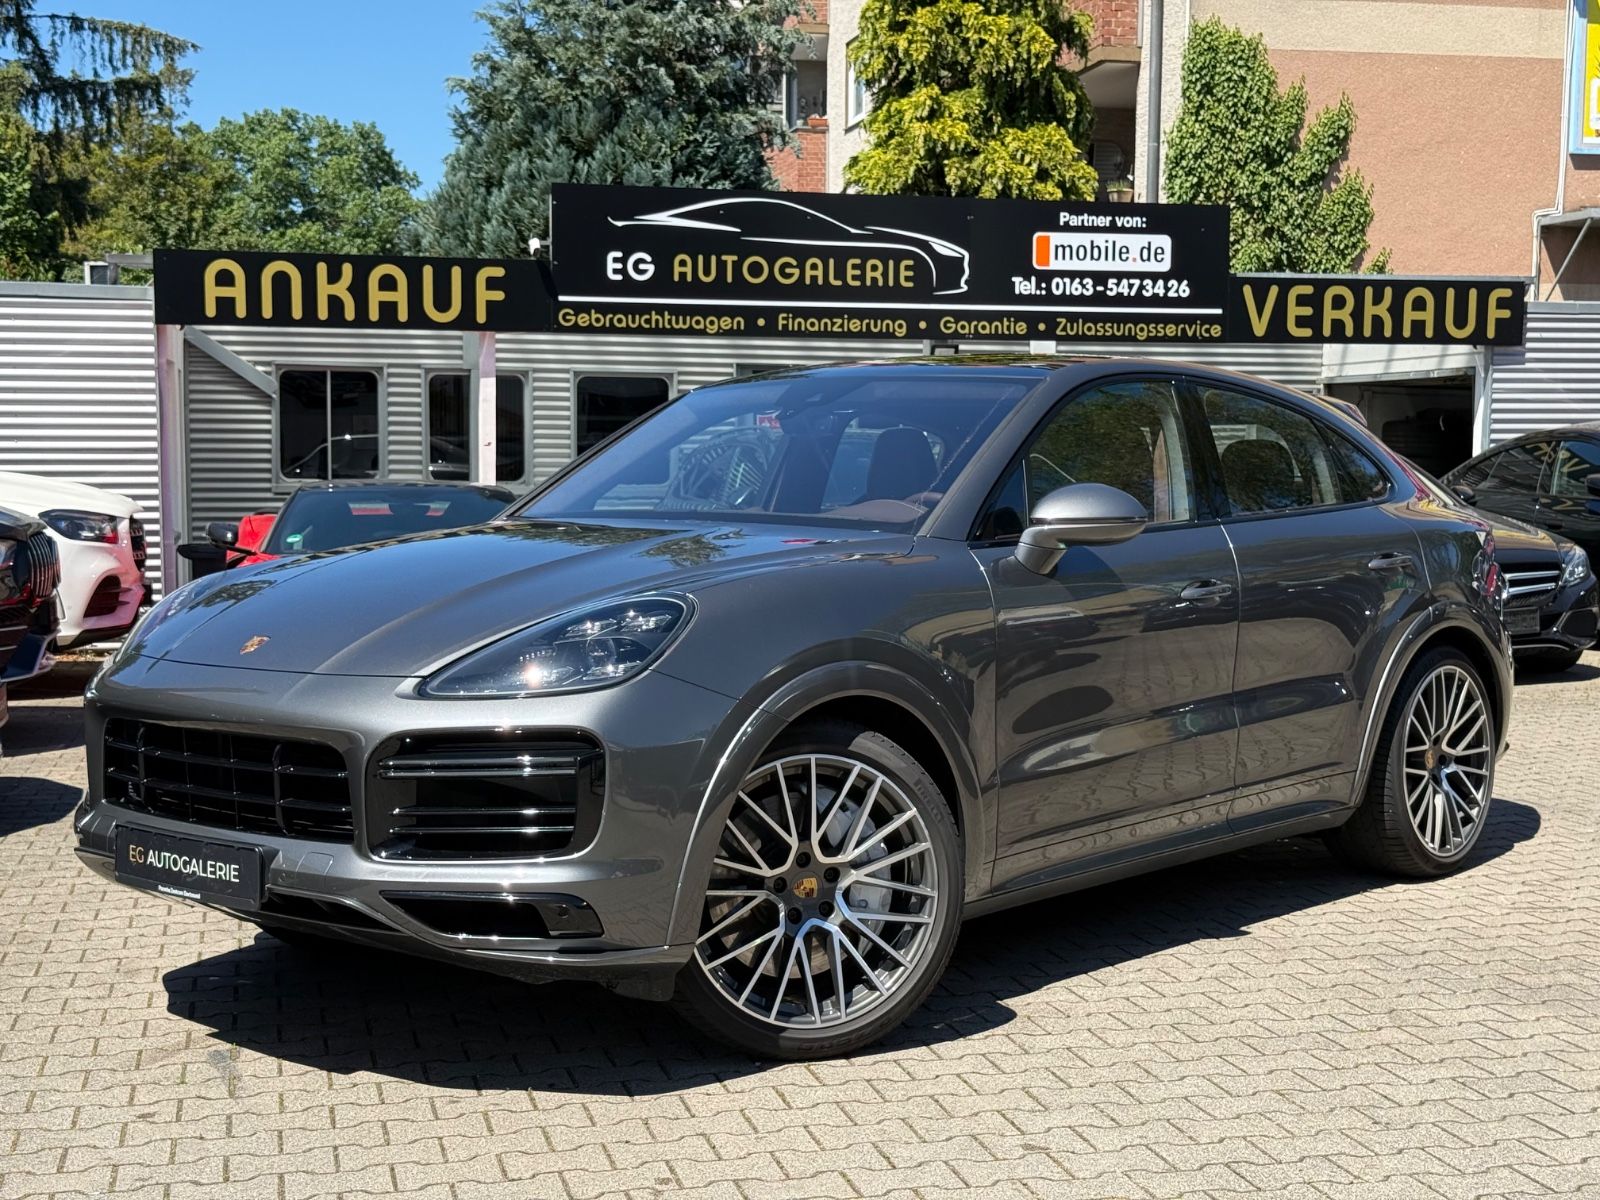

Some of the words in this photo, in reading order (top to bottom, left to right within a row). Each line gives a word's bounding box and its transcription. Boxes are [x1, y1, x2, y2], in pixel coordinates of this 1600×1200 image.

[1059, 211, 1113, 228] Partner
[1114, 215, 1147, 228] von:
[606, 250, 656, 282] EG
[673, 253, 915, 288] AUTOGALERIE
[1053, 240, 1165, 263] mobile.de
[204, 258, 506, 324] ANKAUF
[1011, 276, 1047, 296] Tel.:
[1050, 277, 1191, 298] 0163-5473426
[558, 308, 745, 334] Gebrauchtwagen
[778, 313, 907, 338] Finanzierung
[939, 316, 1028, 335] Garantie
[1055, 317, 1222, 341] Zulassungsservice
[1242, 284, 1513, 340] VERKAUF
[129, 844, 145, 864] EG
[146, 848, 240, 883] AUTOGALERIE
